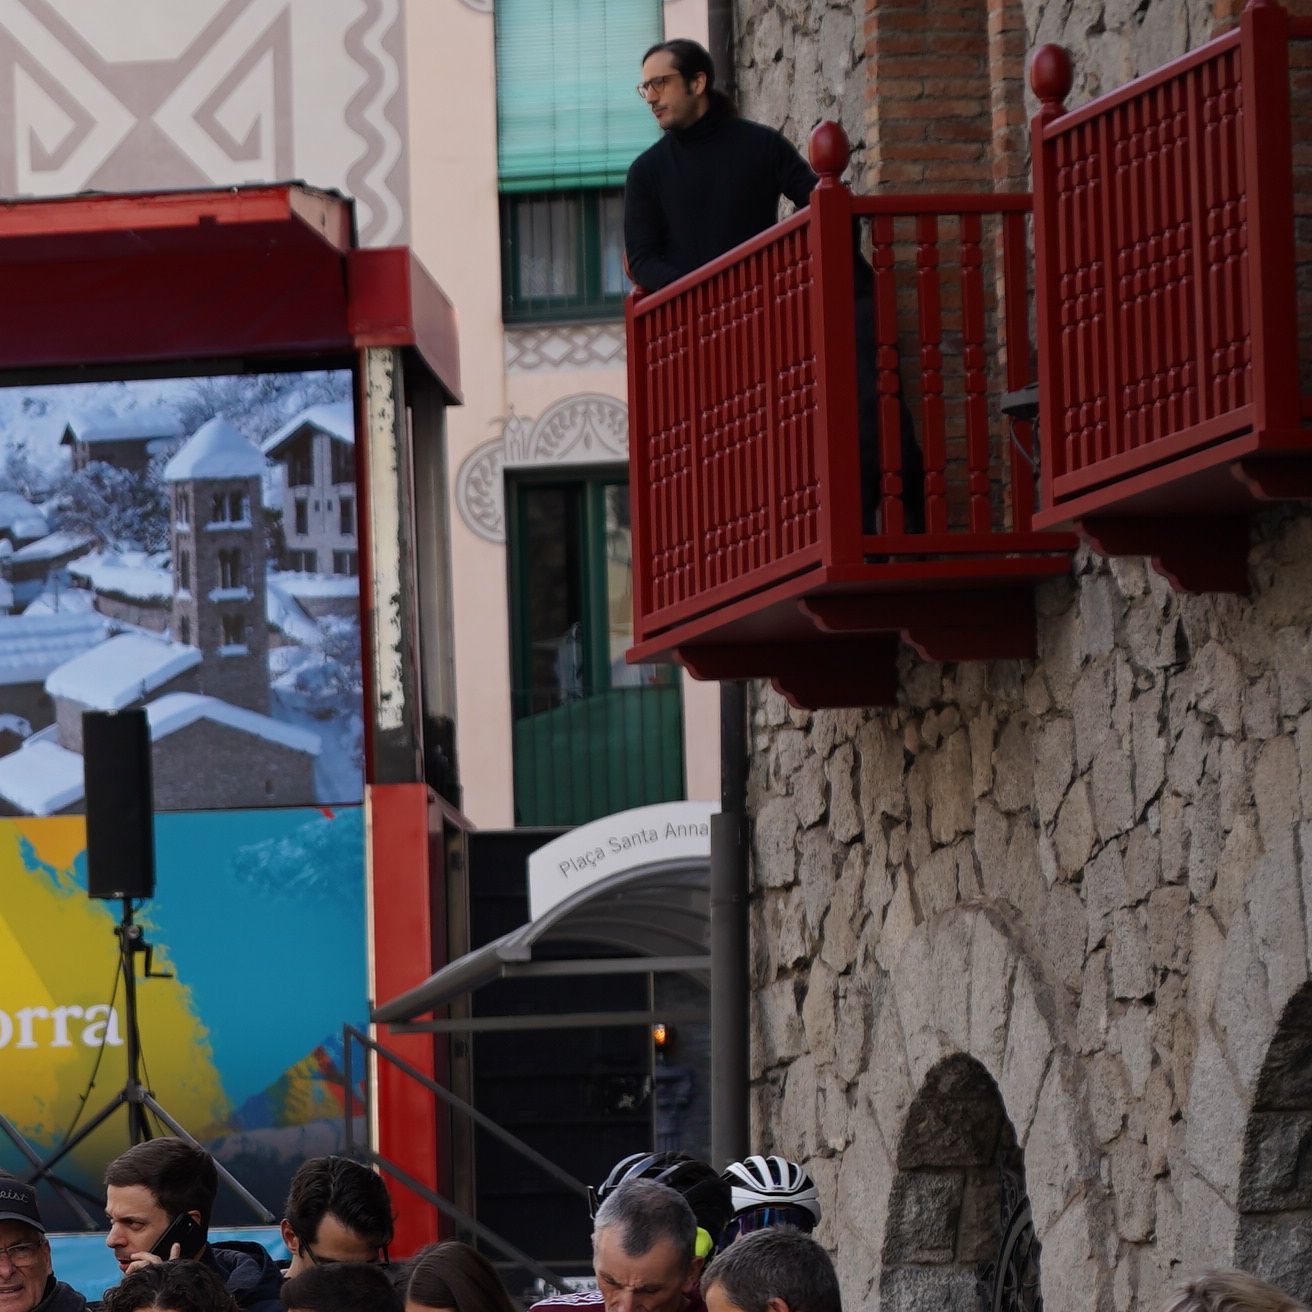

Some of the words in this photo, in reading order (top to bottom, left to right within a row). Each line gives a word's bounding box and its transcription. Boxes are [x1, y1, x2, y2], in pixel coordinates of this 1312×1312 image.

[559, 845, 607, 879] Plaça
[607, 828, 660, 855] Santa
[664, 821, 710, 838] Anna
